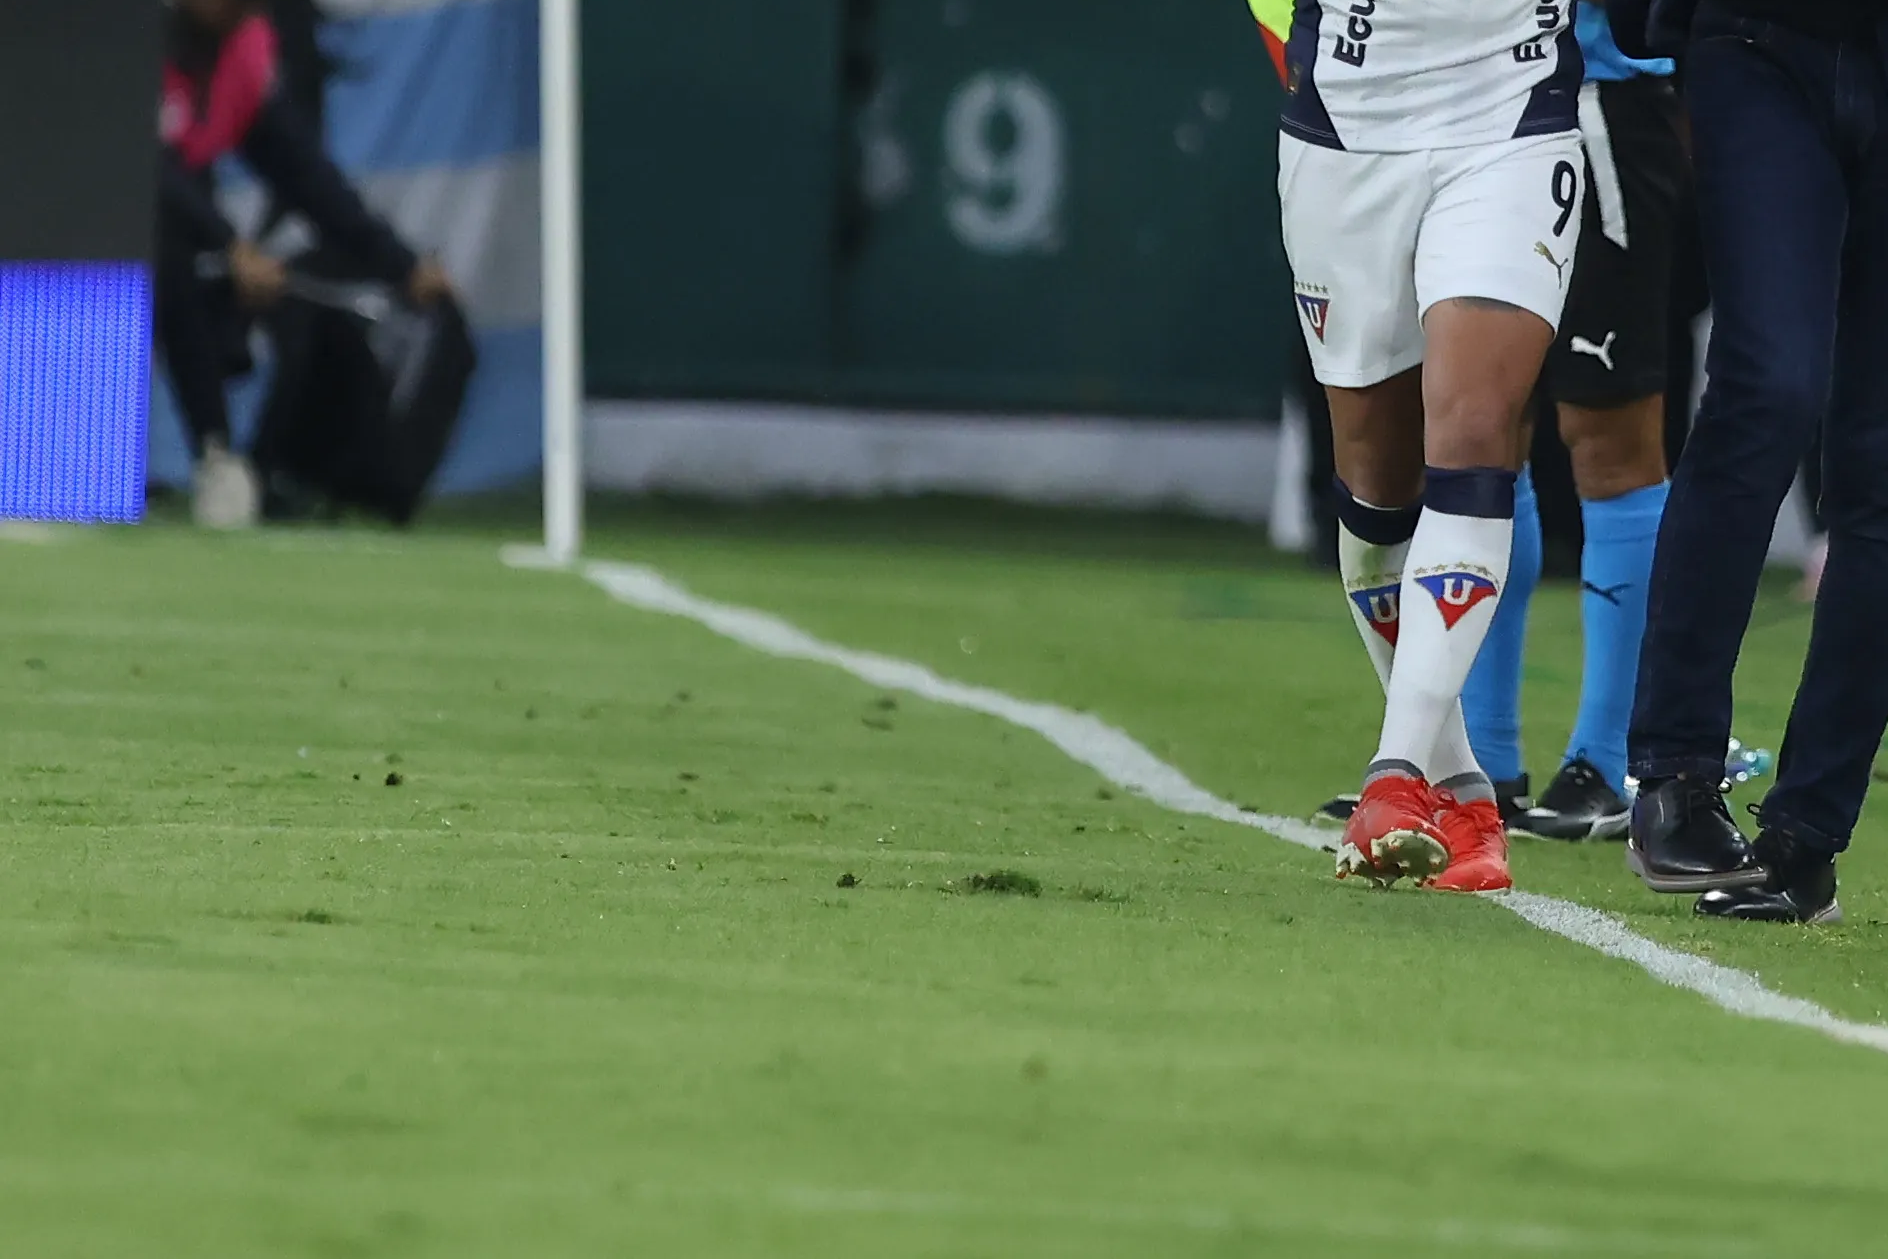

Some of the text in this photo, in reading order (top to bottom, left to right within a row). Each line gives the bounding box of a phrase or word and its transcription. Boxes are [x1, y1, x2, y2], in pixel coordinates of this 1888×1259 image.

[945, 72, 1064, 252] 9
[1552, 160, 1577, 237] 9
[1305, 302, 1322, 329] U
[1442, 577, 1475, 606] U
